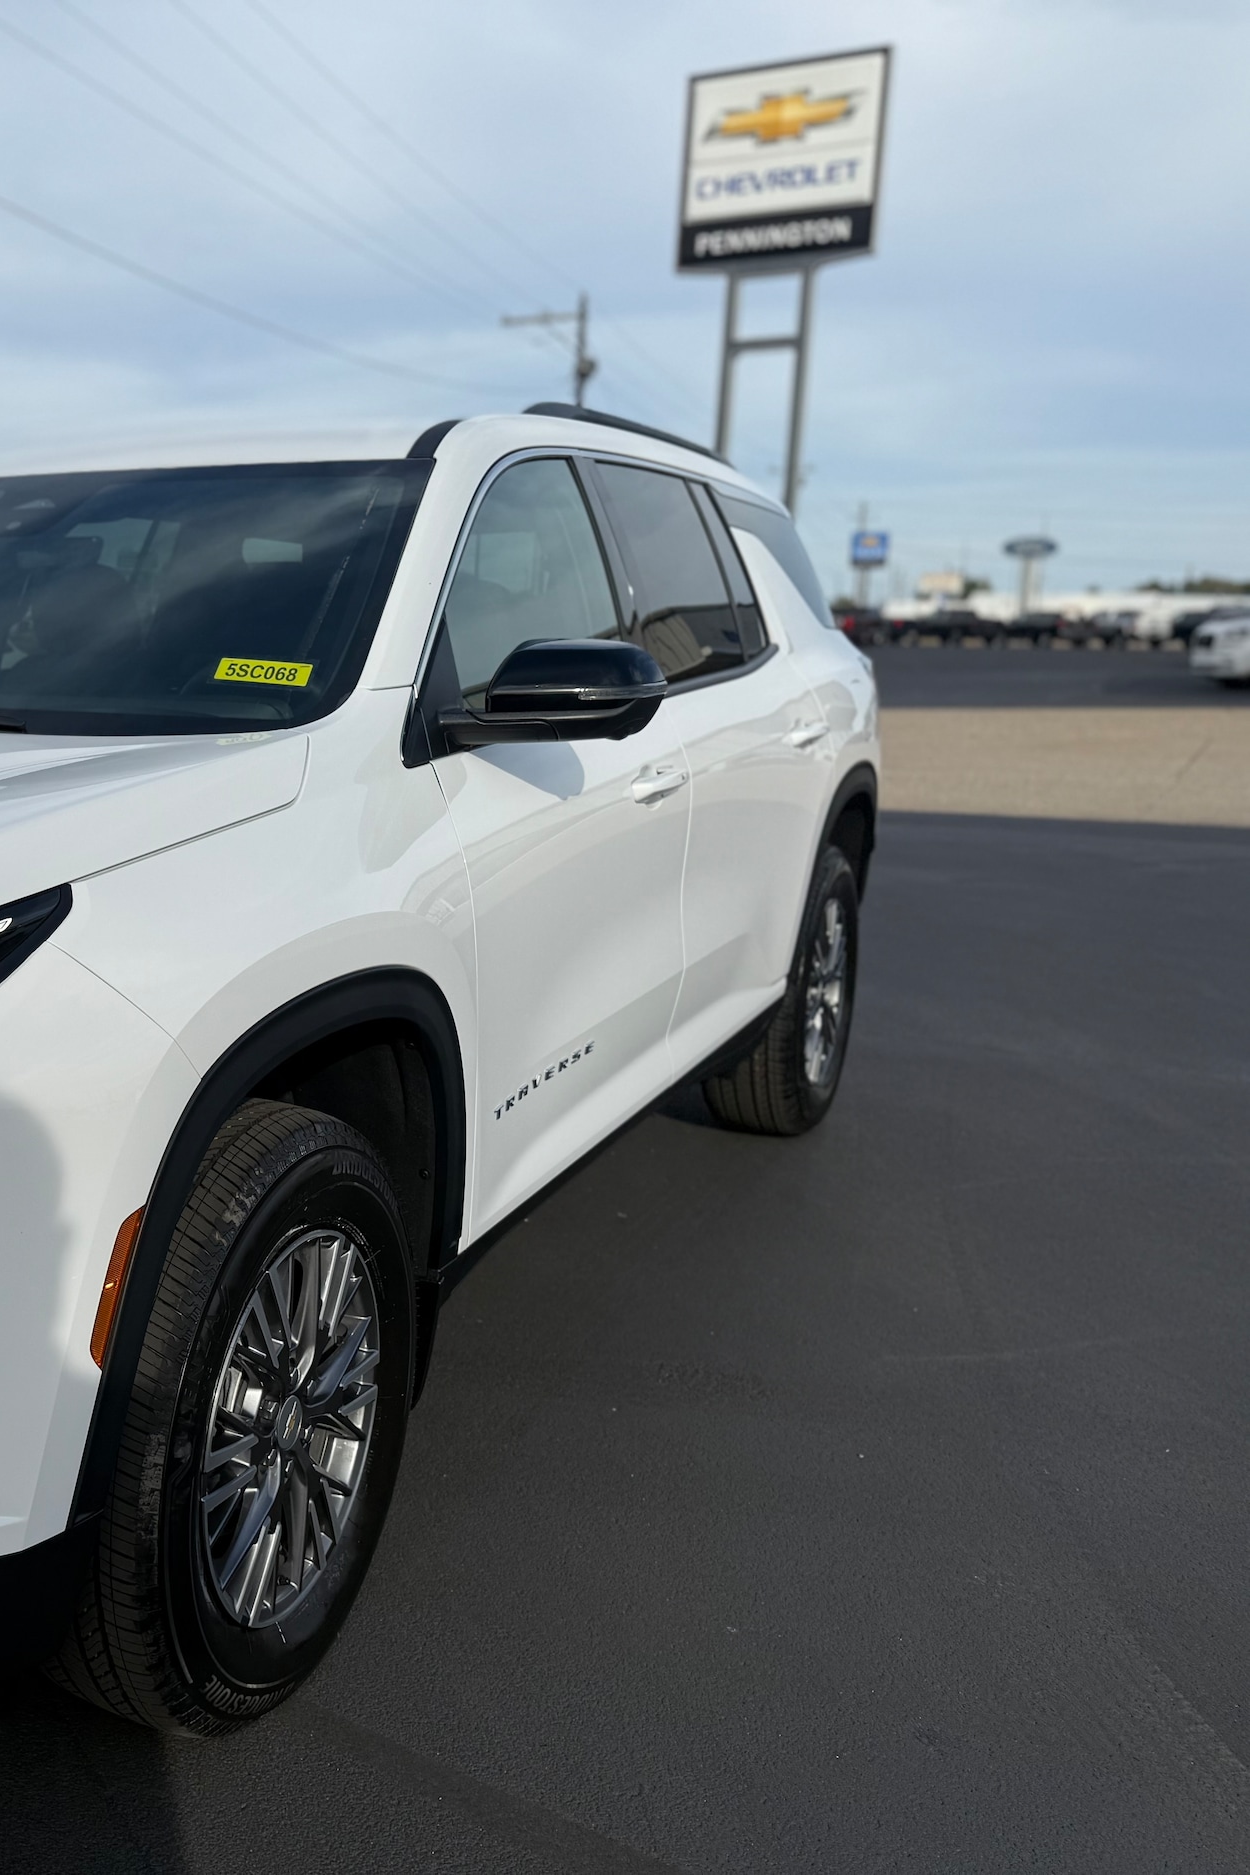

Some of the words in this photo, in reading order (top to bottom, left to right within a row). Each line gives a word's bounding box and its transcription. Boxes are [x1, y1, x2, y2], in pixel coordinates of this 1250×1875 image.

[695, 158, 860, 201] CHEVROLET
[694, 215, 852, 258] PENNINGTON
[225, 663, 298, 682] 5SC068
[493, 1040, 595, 1120] TRAVERSE
